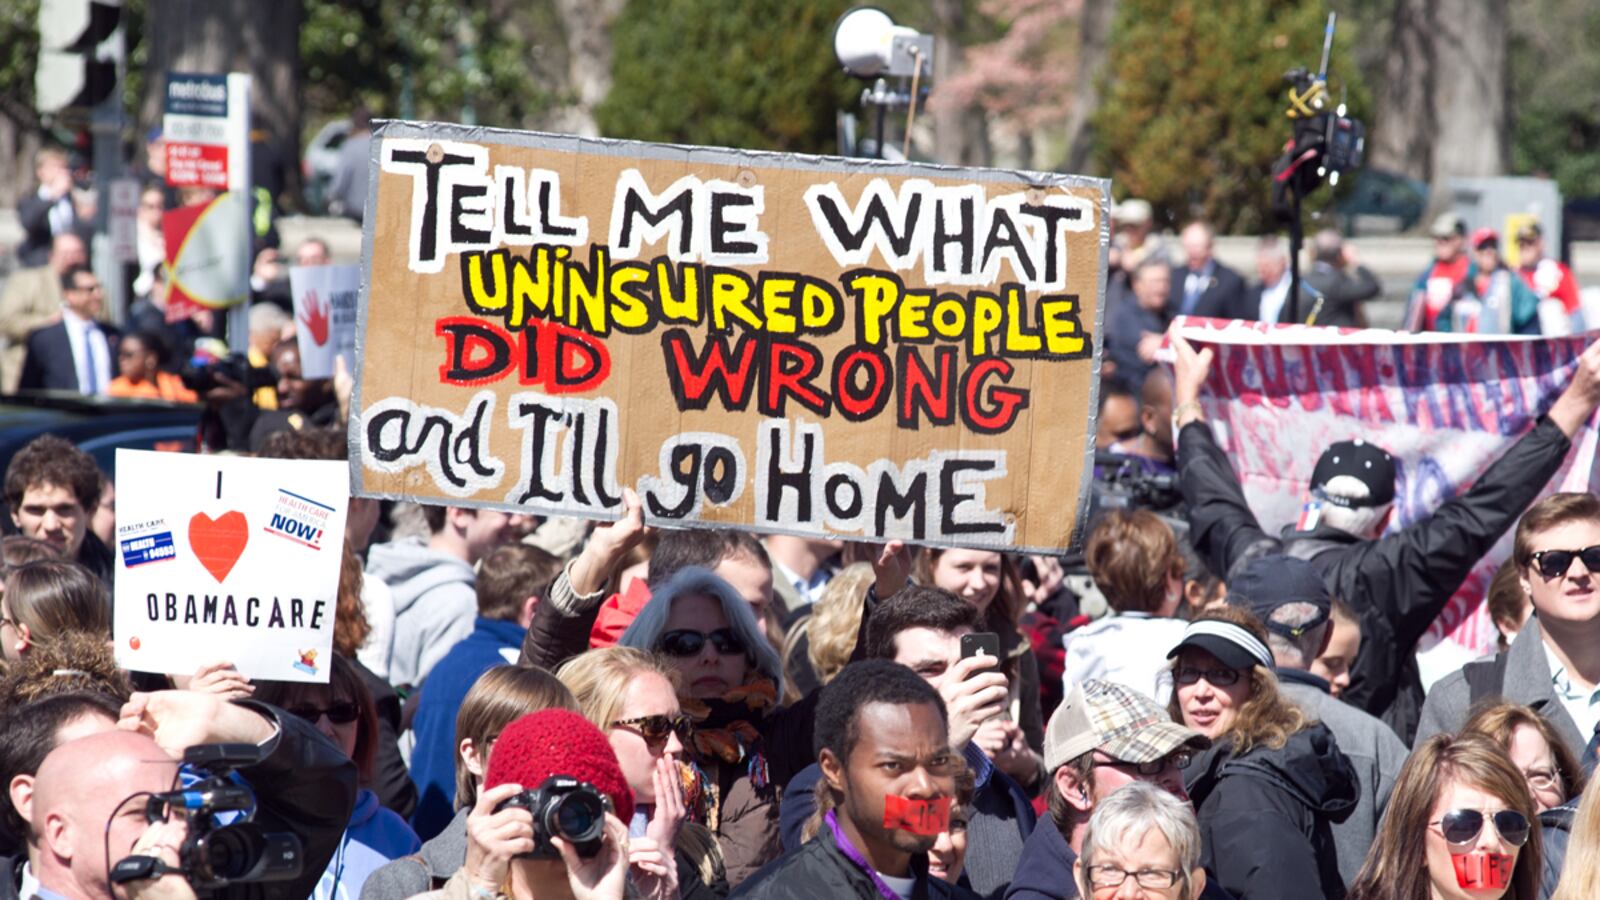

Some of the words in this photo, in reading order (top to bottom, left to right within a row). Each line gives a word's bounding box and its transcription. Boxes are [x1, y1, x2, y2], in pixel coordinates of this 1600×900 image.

[391, 148, 577, 262] TELL
[617, 186, 760, 256] ME
[817, 191, 1083, 284] WHAT
[462, 244, 843, 336] UNINSURED
[841, 269, 1091, 359] PEOPLE
[440, 320, 607, 389] DID
[663, 328, 1029, 433] WRONG
[215, 470, 223, 500] I
[366, 398, 497, 488] and
[518, 402, 623, 508] I'll
[646, 443, 737, 519] go
[765, 427, 1007, 540] HOME
[270, 513, 323, 544] NOW!
[147, 592, 326, 630] OBAMACARE
[1463, 854, 1511, 885] LIFE
